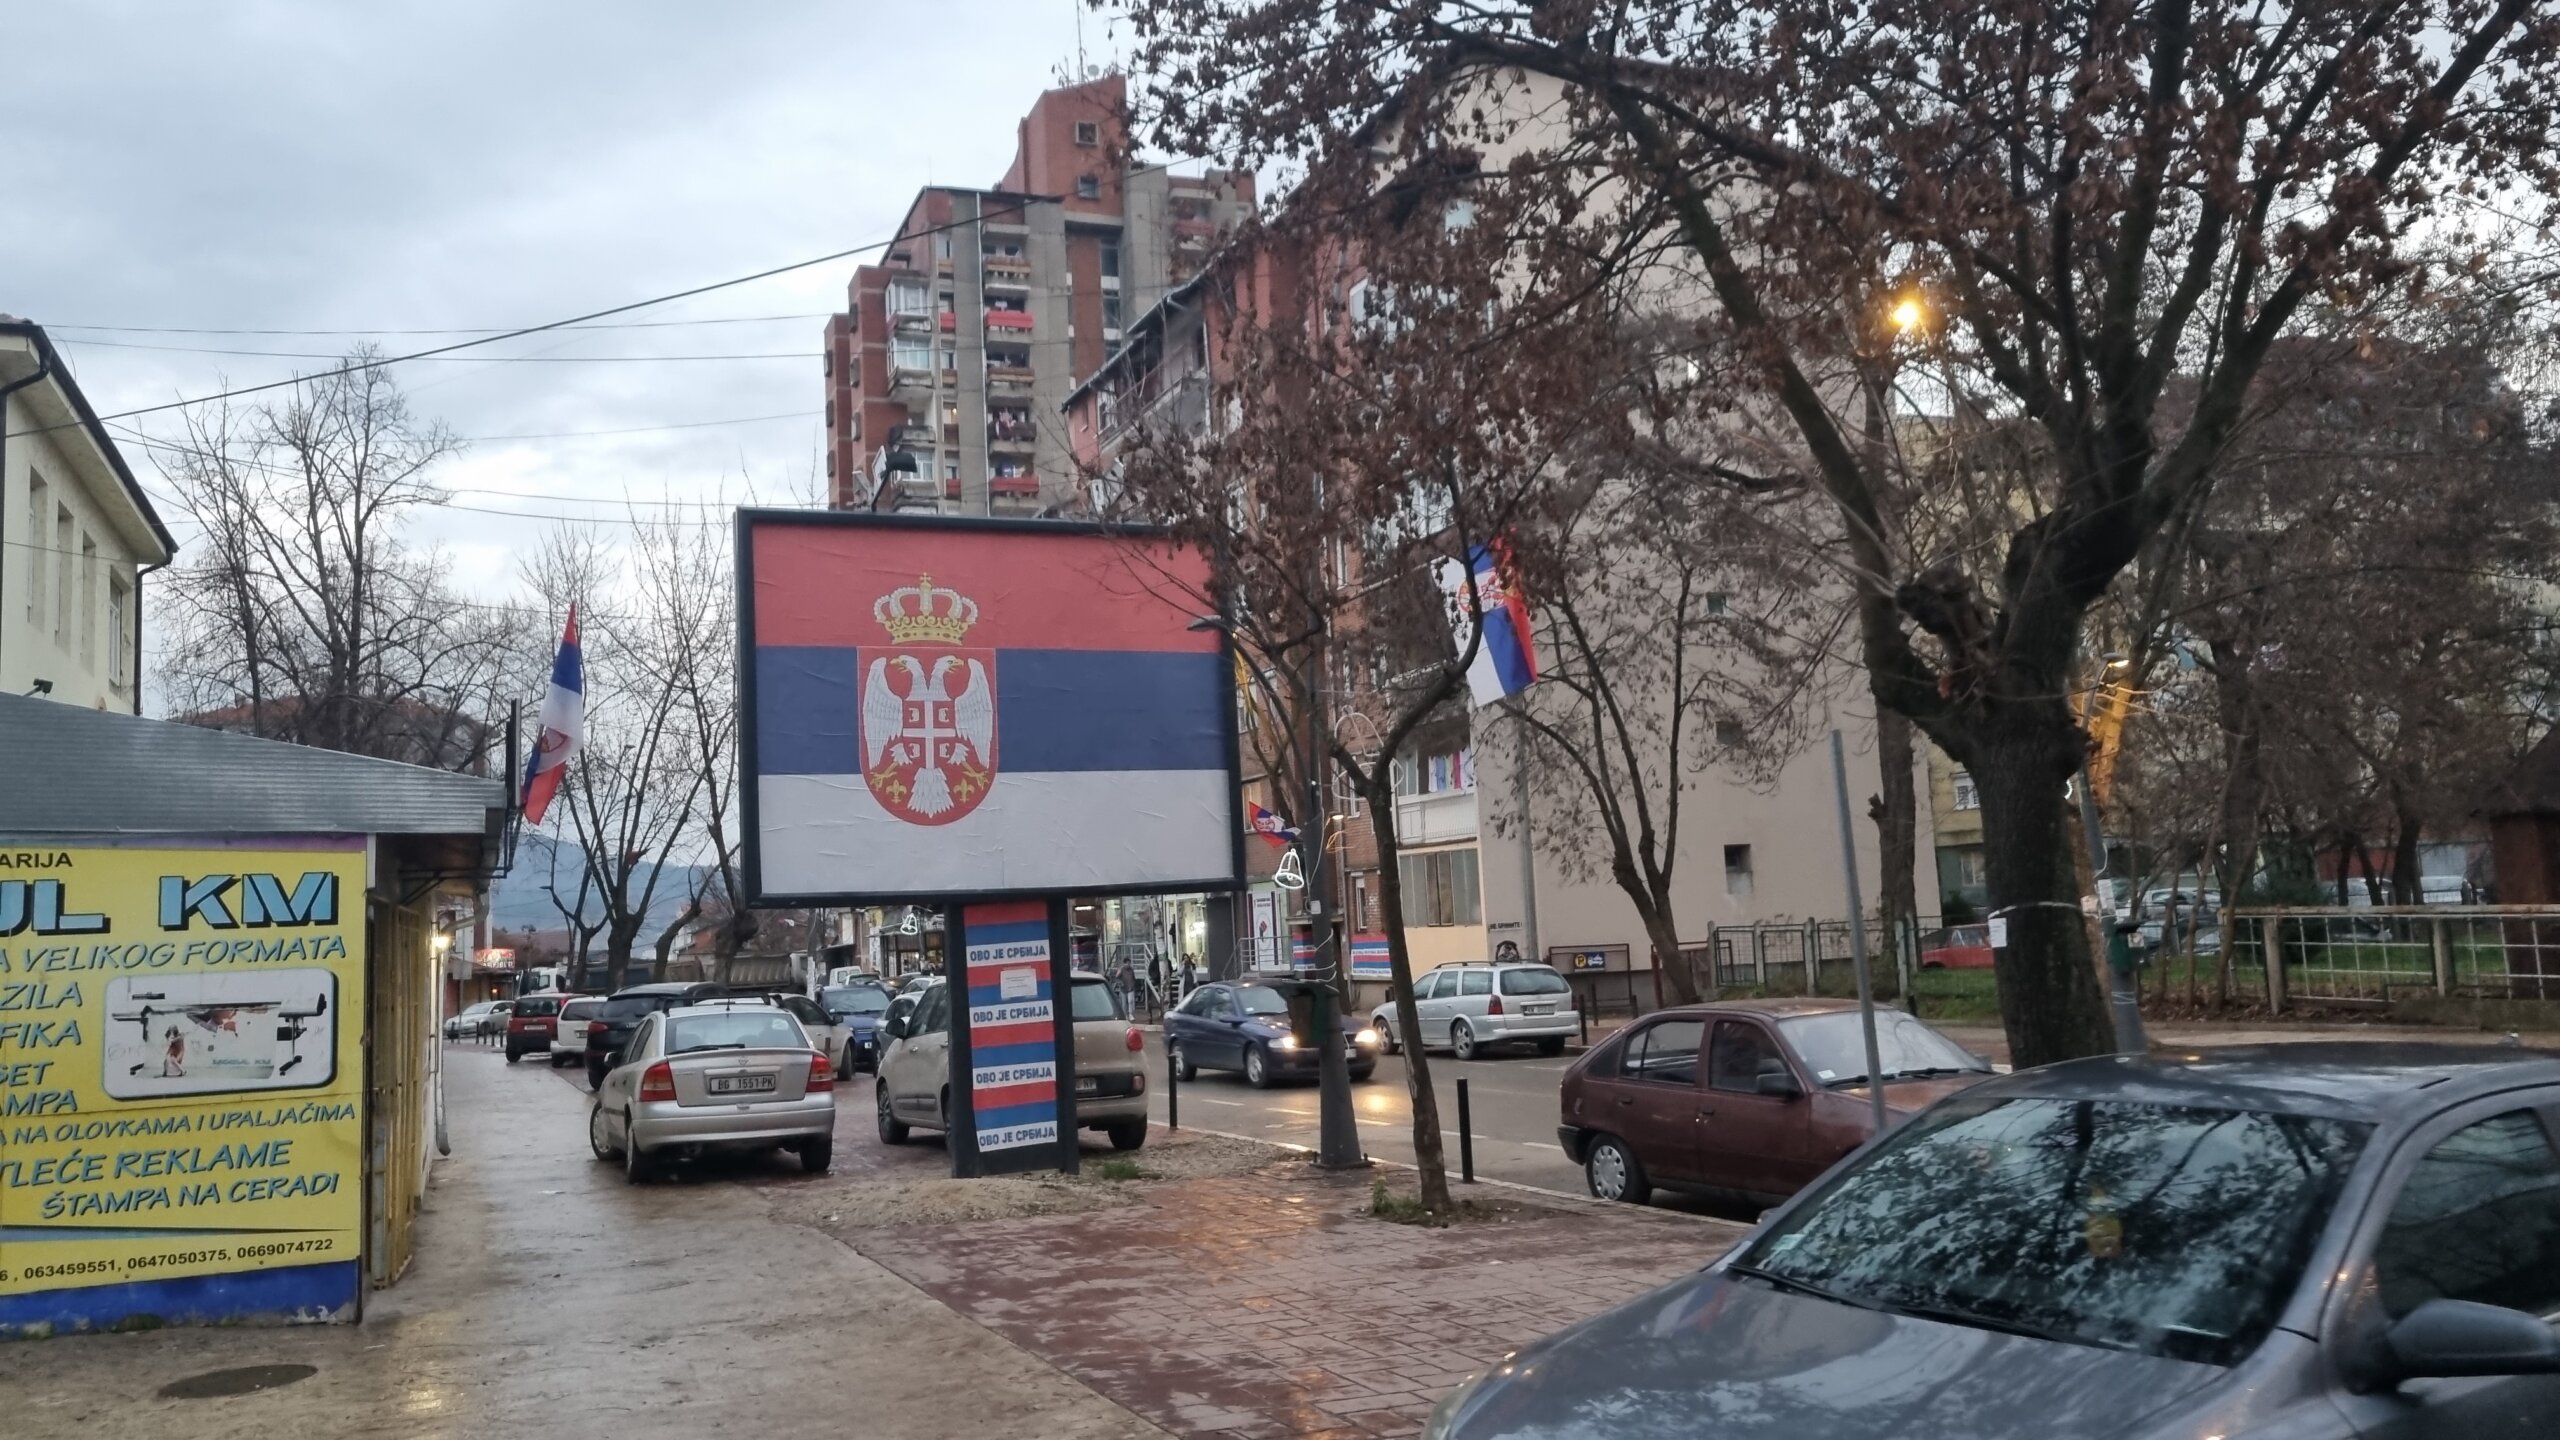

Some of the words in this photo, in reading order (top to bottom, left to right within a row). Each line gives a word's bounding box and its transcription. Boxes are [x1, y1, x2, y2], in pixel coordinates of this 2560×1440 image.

[0, 853, 73, 868] ARIJA
[159, 872, 339, 931] KM
[24, 942, 176, 973] VELIKOG
[181, 935, 347, 966] FORMATA
[970, 950, 990, 961] ОВО
[993, 949, 1004, 960] ЈЕ
[1007, 945, 1046, 958] СРБИЈА
[0, 981, 83, 1010] ZILA
[973, 1011, 993, 1023] ОВО
[996, 1009, 1007, 1020] ЈЕ
[1009, 1005, 1049, 1019] СРБИЈА
[0, 1020, 82, 1048] FIKA
[976, 1072, 996, 1084] ОВО
[999, 1070, 1010, 1081] ЈЕ
[1013, 1067, 1052, 1080] СРБИЈА
[13, 1125, 48, 1144] NA
[54, 1114, 191, 1141] OLOVKAMA
[197, 1115, 204, 1131] I
[209, 1102, 356, 1131] UPALJAČIMA
[979, 1134, 999, 1147] ОВО
[1002, 1132, 1013, 1143] ЈЕ
[1016, 1126, 1055, 1141] СРБИЈА
[113, 1139, 293, 1178] REKLAME
[178, 1184, 221, 1206] NA
[226, 1173, 340, 1203] CERADI
[24, 1259, 122, 1280] 063459551,
[127, 1249, 231, 1270] 0647050375,
[237, 1238, 333, 1259] 0669074722
